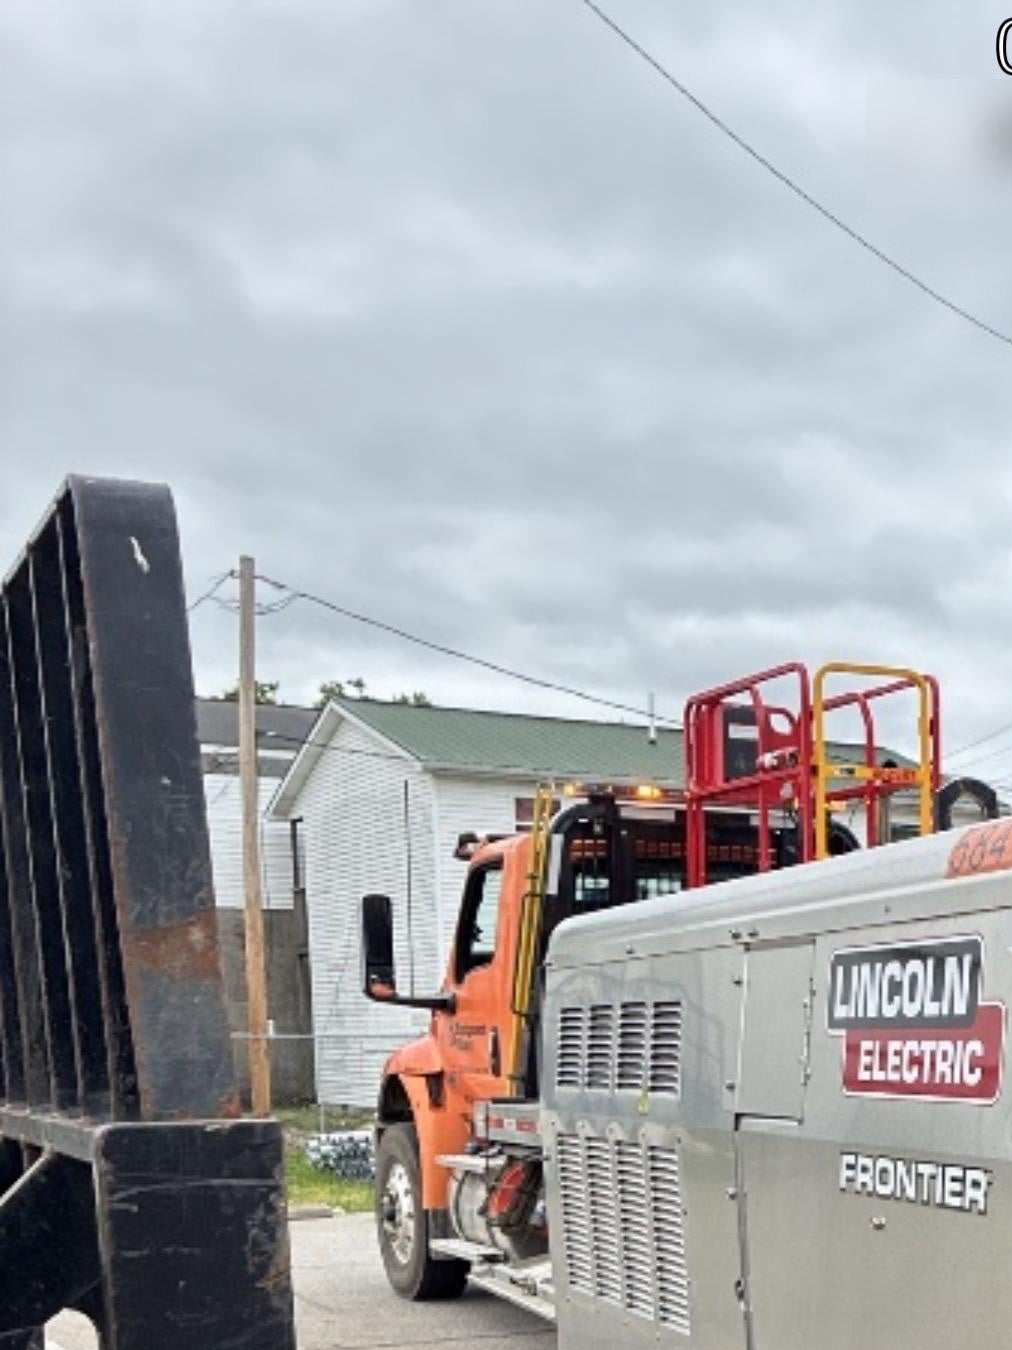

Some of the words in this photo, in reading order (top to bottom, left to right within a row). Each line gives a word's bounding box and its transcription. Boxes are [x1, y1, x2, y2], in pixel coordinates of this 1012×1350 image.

[833, 954, 973, 1019] LINCOLN
[857, 1038, 985, 1087] ELECTRIC
[839, 1152, 990, 1214] FRONTIER
